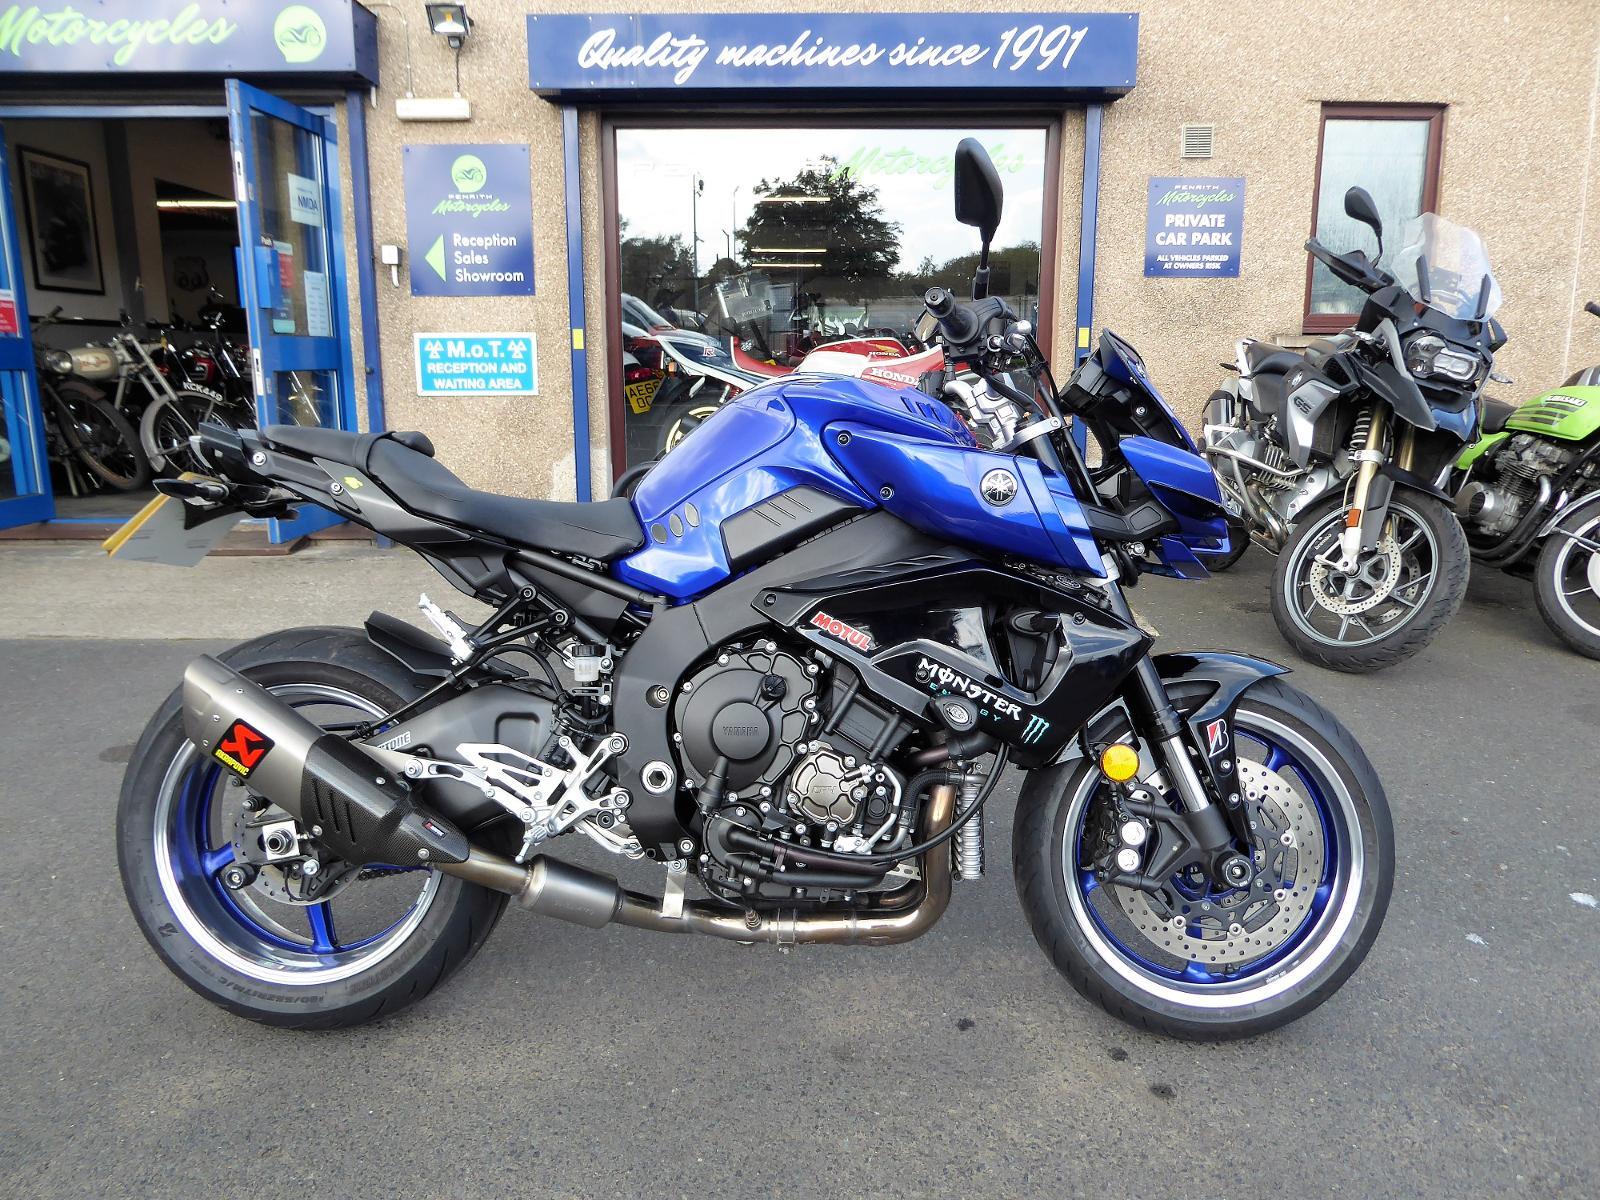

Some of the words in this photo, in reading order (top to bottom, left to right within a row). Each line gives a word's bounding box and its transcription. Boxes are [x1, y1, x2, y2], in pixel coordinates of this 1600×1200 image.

[0, 4, 237, 66] Motorcycles
[578, 28, 710, 84] Quality
[716, 31, 885, 67] machines
[889, 35, 988, 67] since
[992, 26, 1088, 70] 1991
[1153, 189, 1237, 209] Motorcycles
[432, 199, 511, 218] Motorcycles
[1165, 214, 1226, 228] PRIVATE
[453, 233, 517, 249] Reception
[1155, 232, 1187, 246] CAR
[1191, 232, 1232, 246] PARK
[454, 250, 489, 265] Sales
[455, 268, 524, 282] Showroom
[447, 340, 505, 358] M.o.T.
[427, 362, 498, 374] RECEPTION
[500, 362, 527, 374] AND
[433, 378, 486, 389] WAITING
[488, 378, 523, 389] AREA
[811, 611, 871, 652] MOTUL
